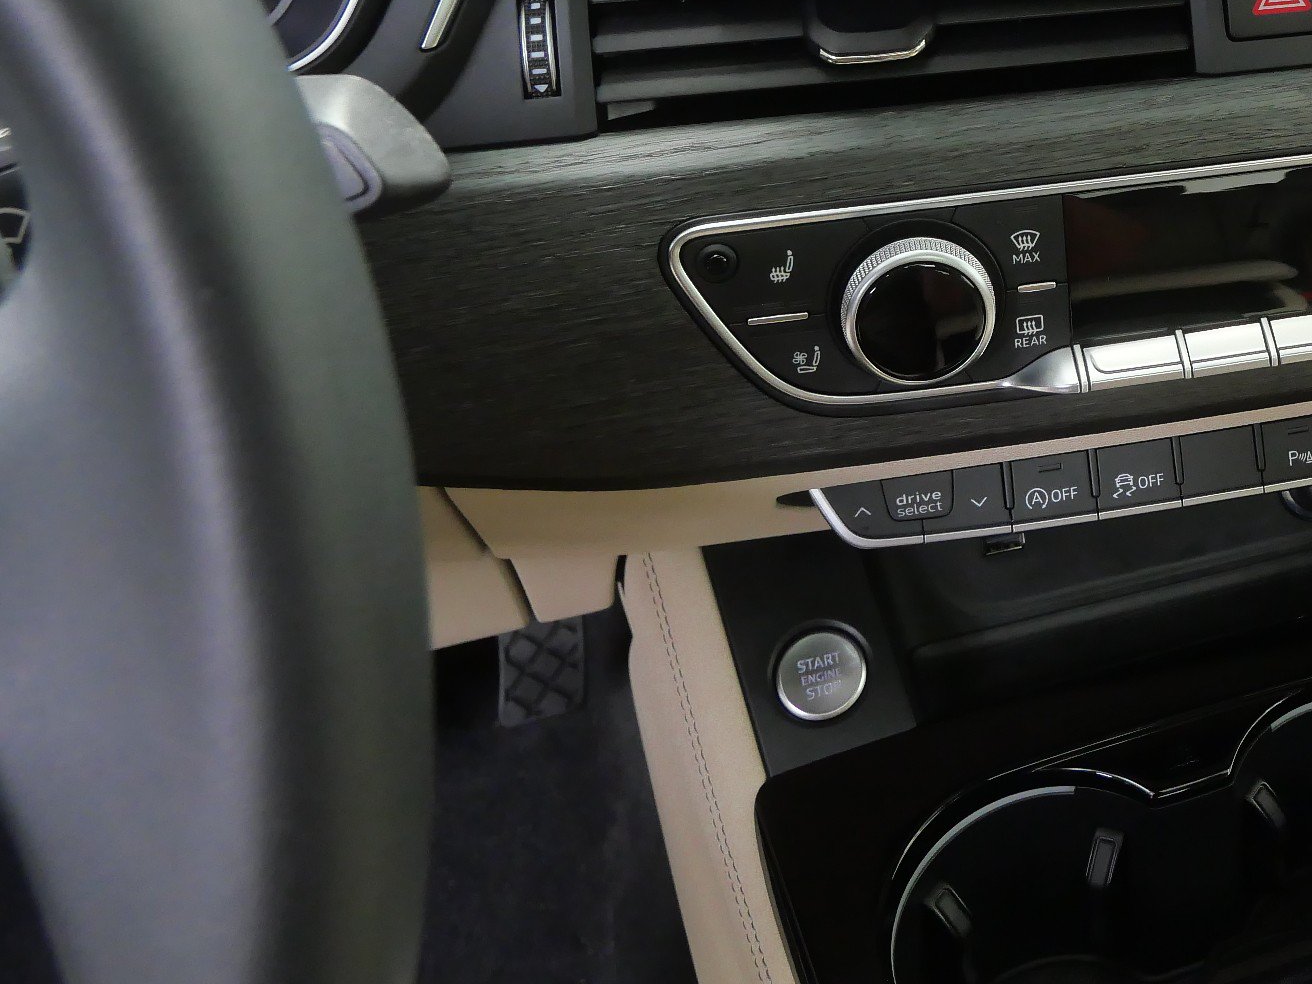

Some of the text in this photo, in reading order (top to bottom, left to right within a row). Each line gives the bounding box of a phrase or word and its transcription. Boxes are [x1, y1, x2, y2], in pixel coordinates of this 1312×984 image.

[1012, 251, 1041, 265] MAX
[1014, 335, 1047, 349] REAR
[1288, 450, 1299, 467] P
[1137, 472, 1165, 490] OFF
[895, 489, 943, 506] drive
[1051, 486, 1079, 503] OFF
[896, 501, 943, 518] select
[797, 652, 840, 673] START
